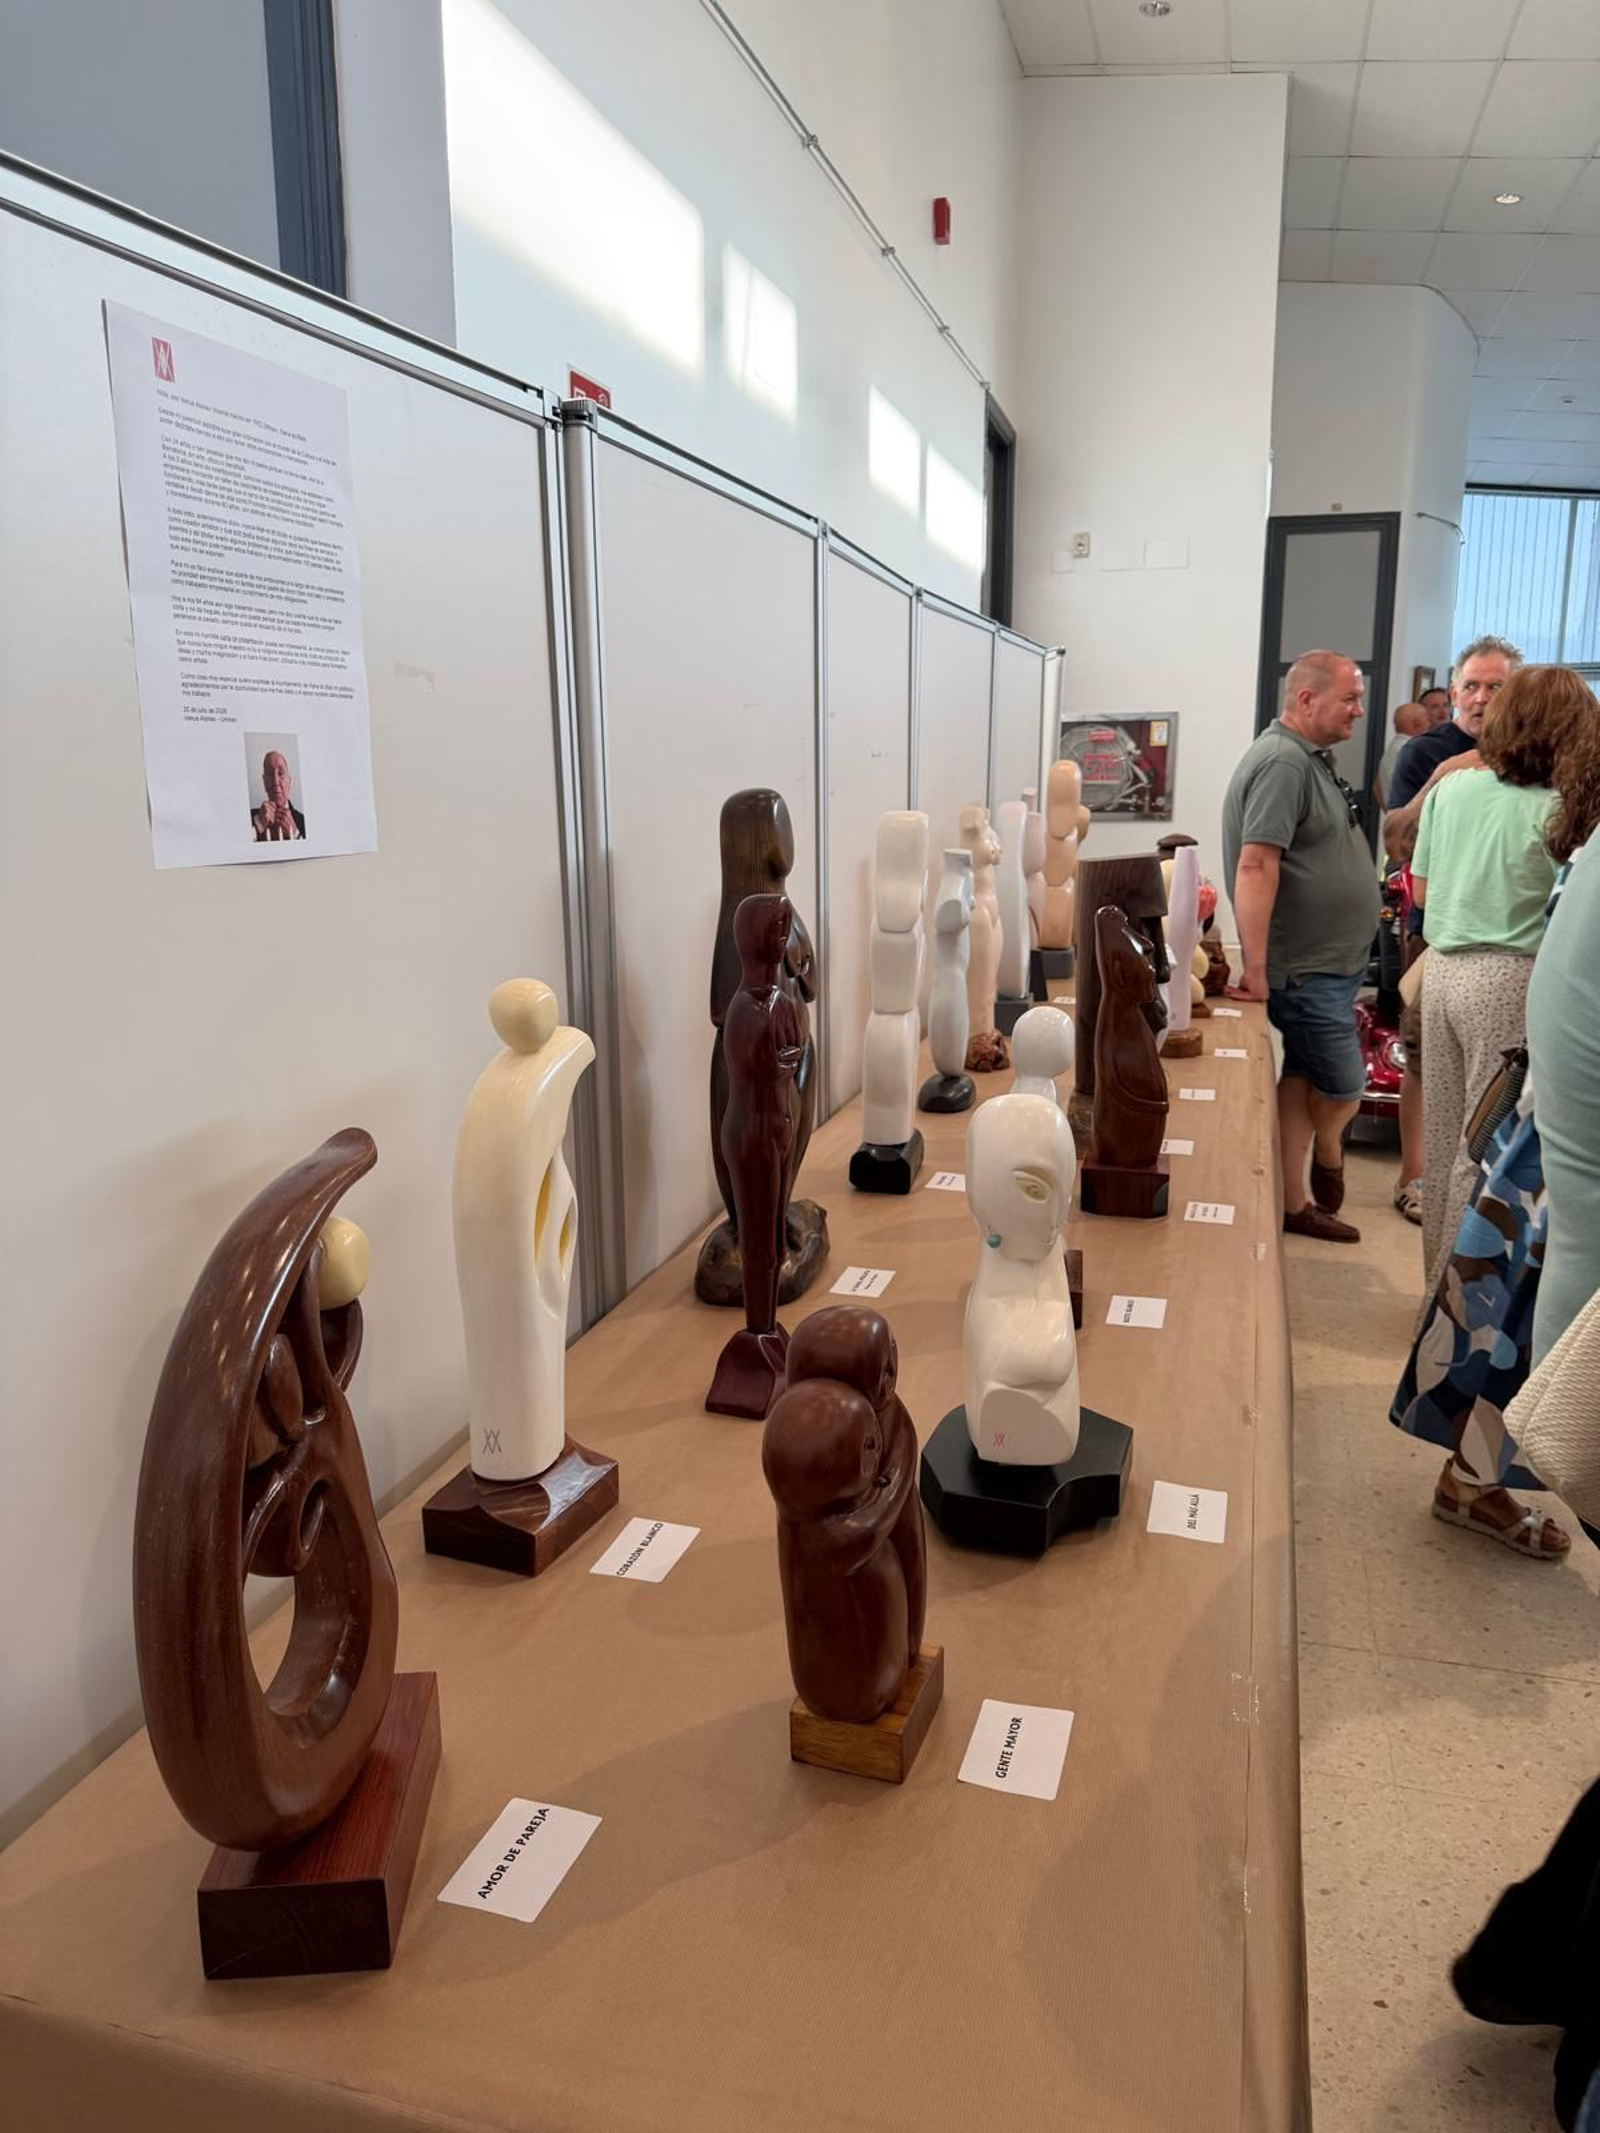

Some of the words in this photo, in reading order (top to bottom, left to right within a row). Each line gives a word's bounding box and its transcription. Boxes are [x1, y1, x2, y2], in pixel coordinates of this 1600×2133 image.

[616, 1547, 645, 1576] CORAZÓN
[639, 1522, 664, 1547] BLANCO
[1003, 1717, 1023, 1750] MAYOR
[995, 1750, 1013, 1779] GENTE
[477, 1863, 510, 1899] AMOR
[503, 1847, 521, 1863] DE
[515, 1807, 550, 1846] PAREJA
